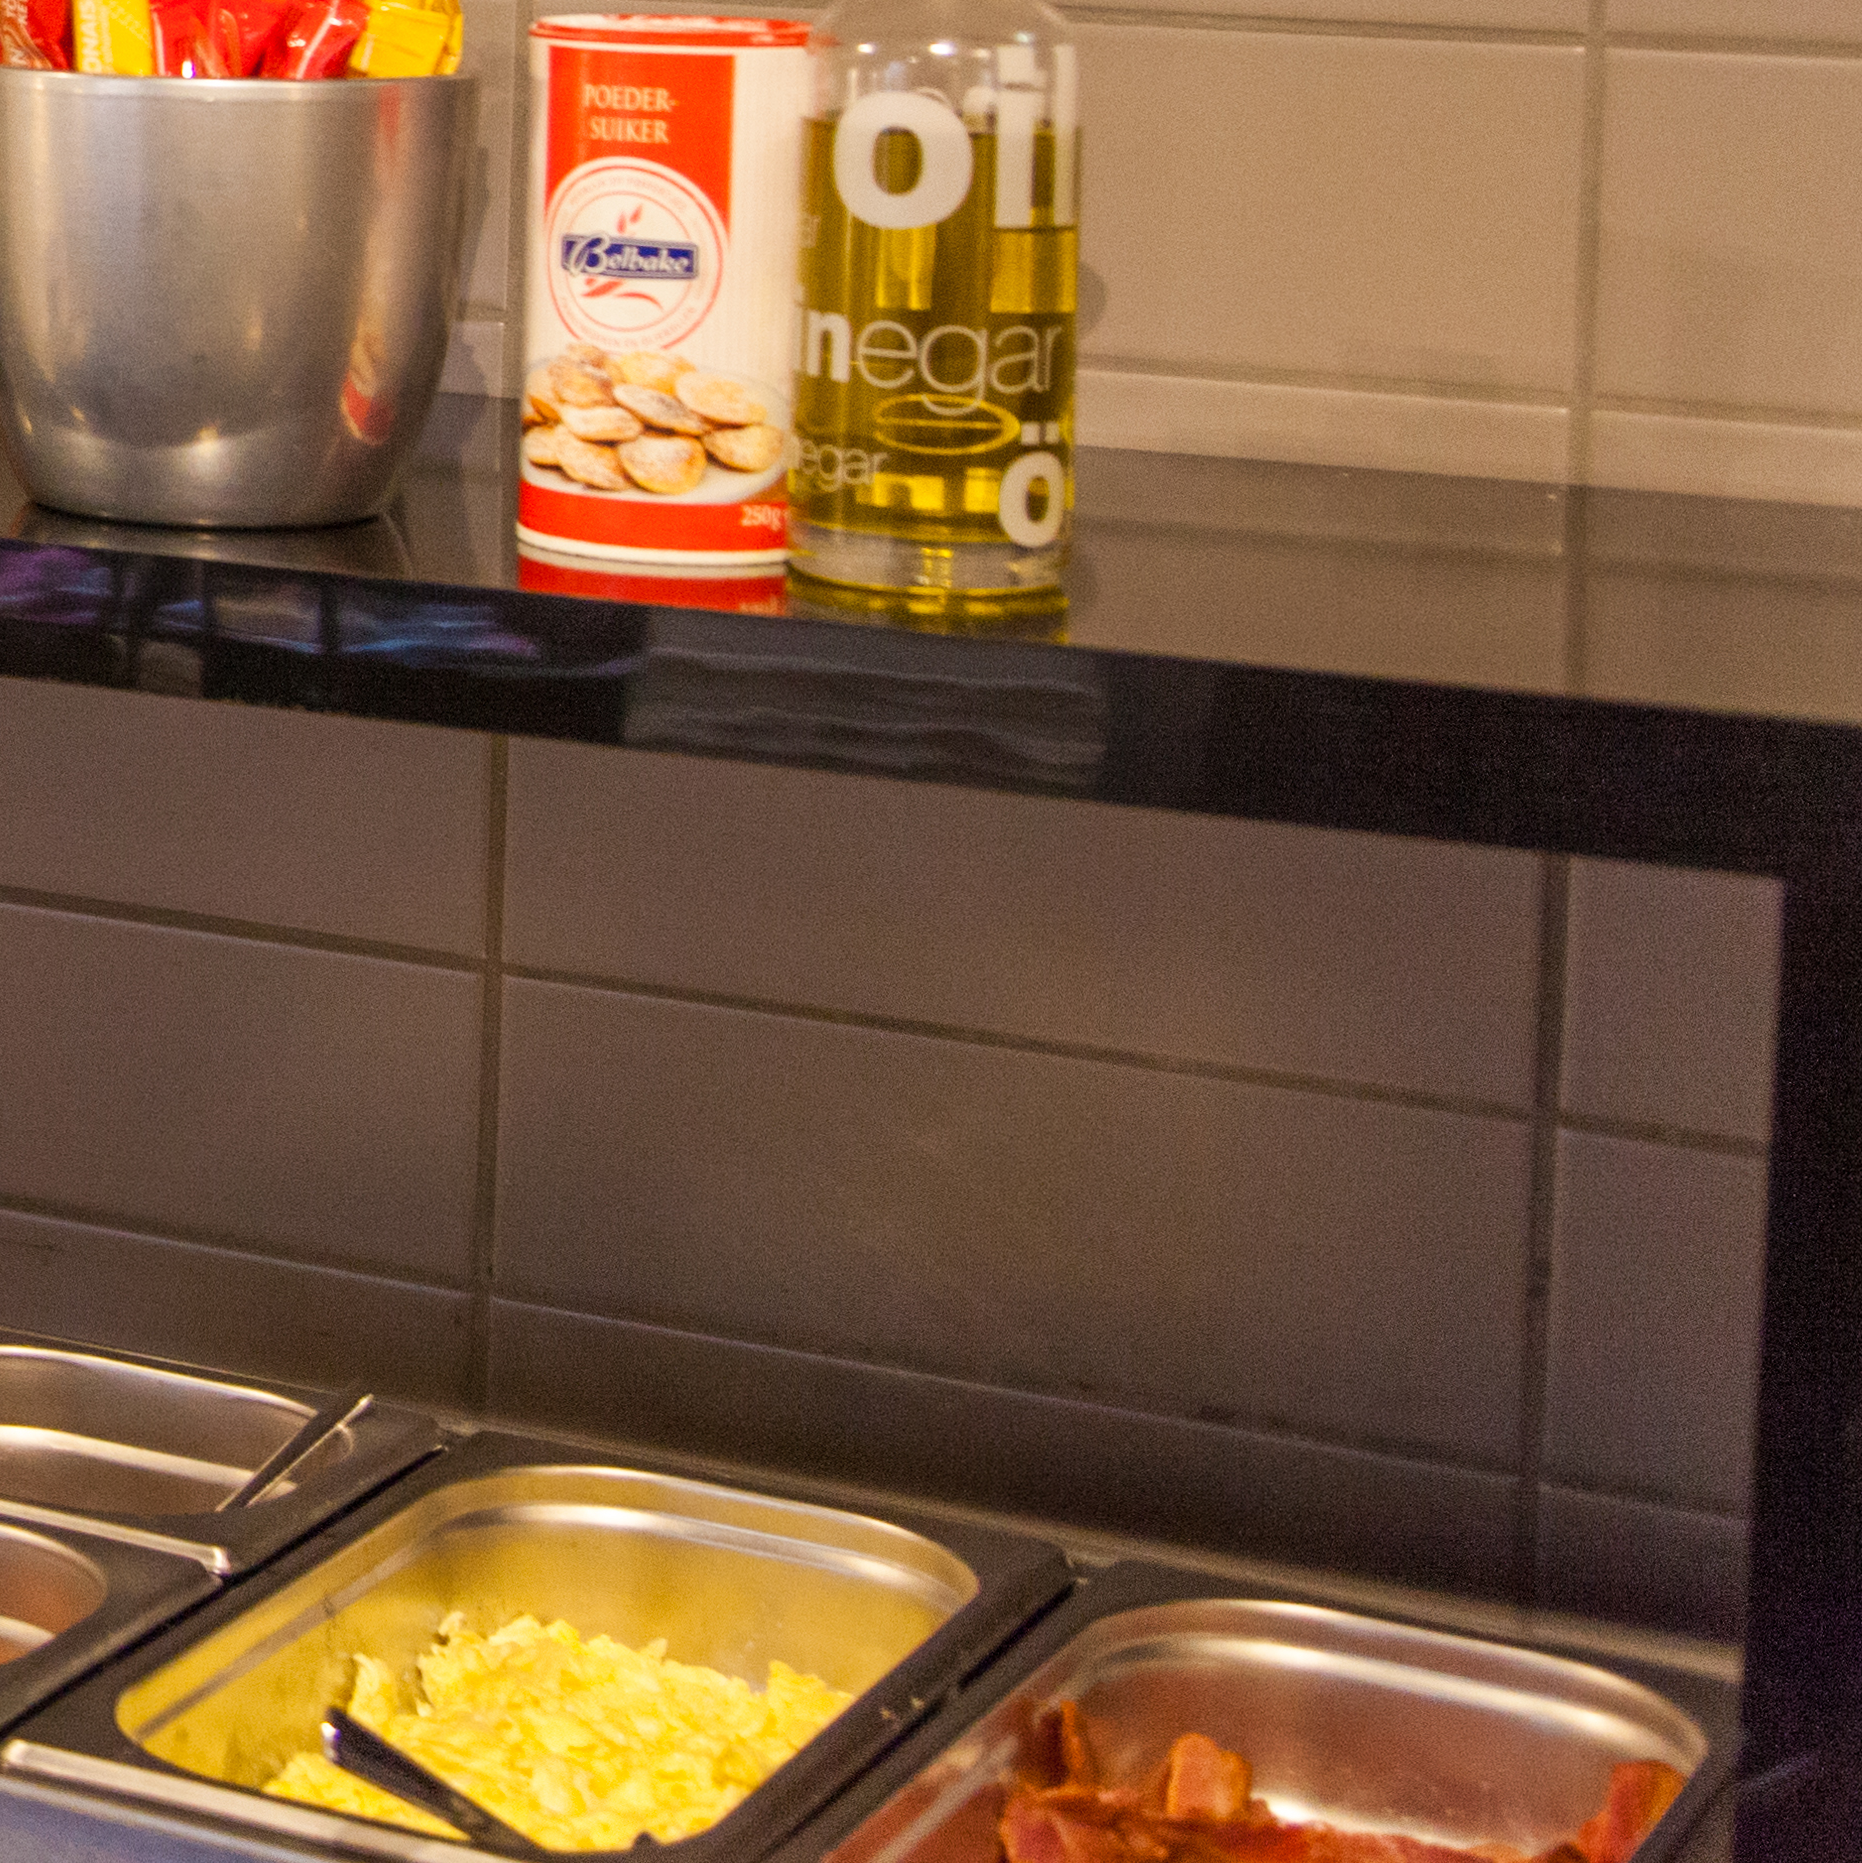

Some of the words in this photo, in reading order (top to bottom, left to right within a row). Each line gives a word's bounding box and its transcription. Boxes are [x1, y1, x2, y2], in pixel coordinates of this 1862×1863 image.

[589, 116, 669, 144] SUIKER
[833, 42, 1076, 230] oil
[567, 229, 691, 277] Belbake
[793, 286, 1063, 417] inegar
